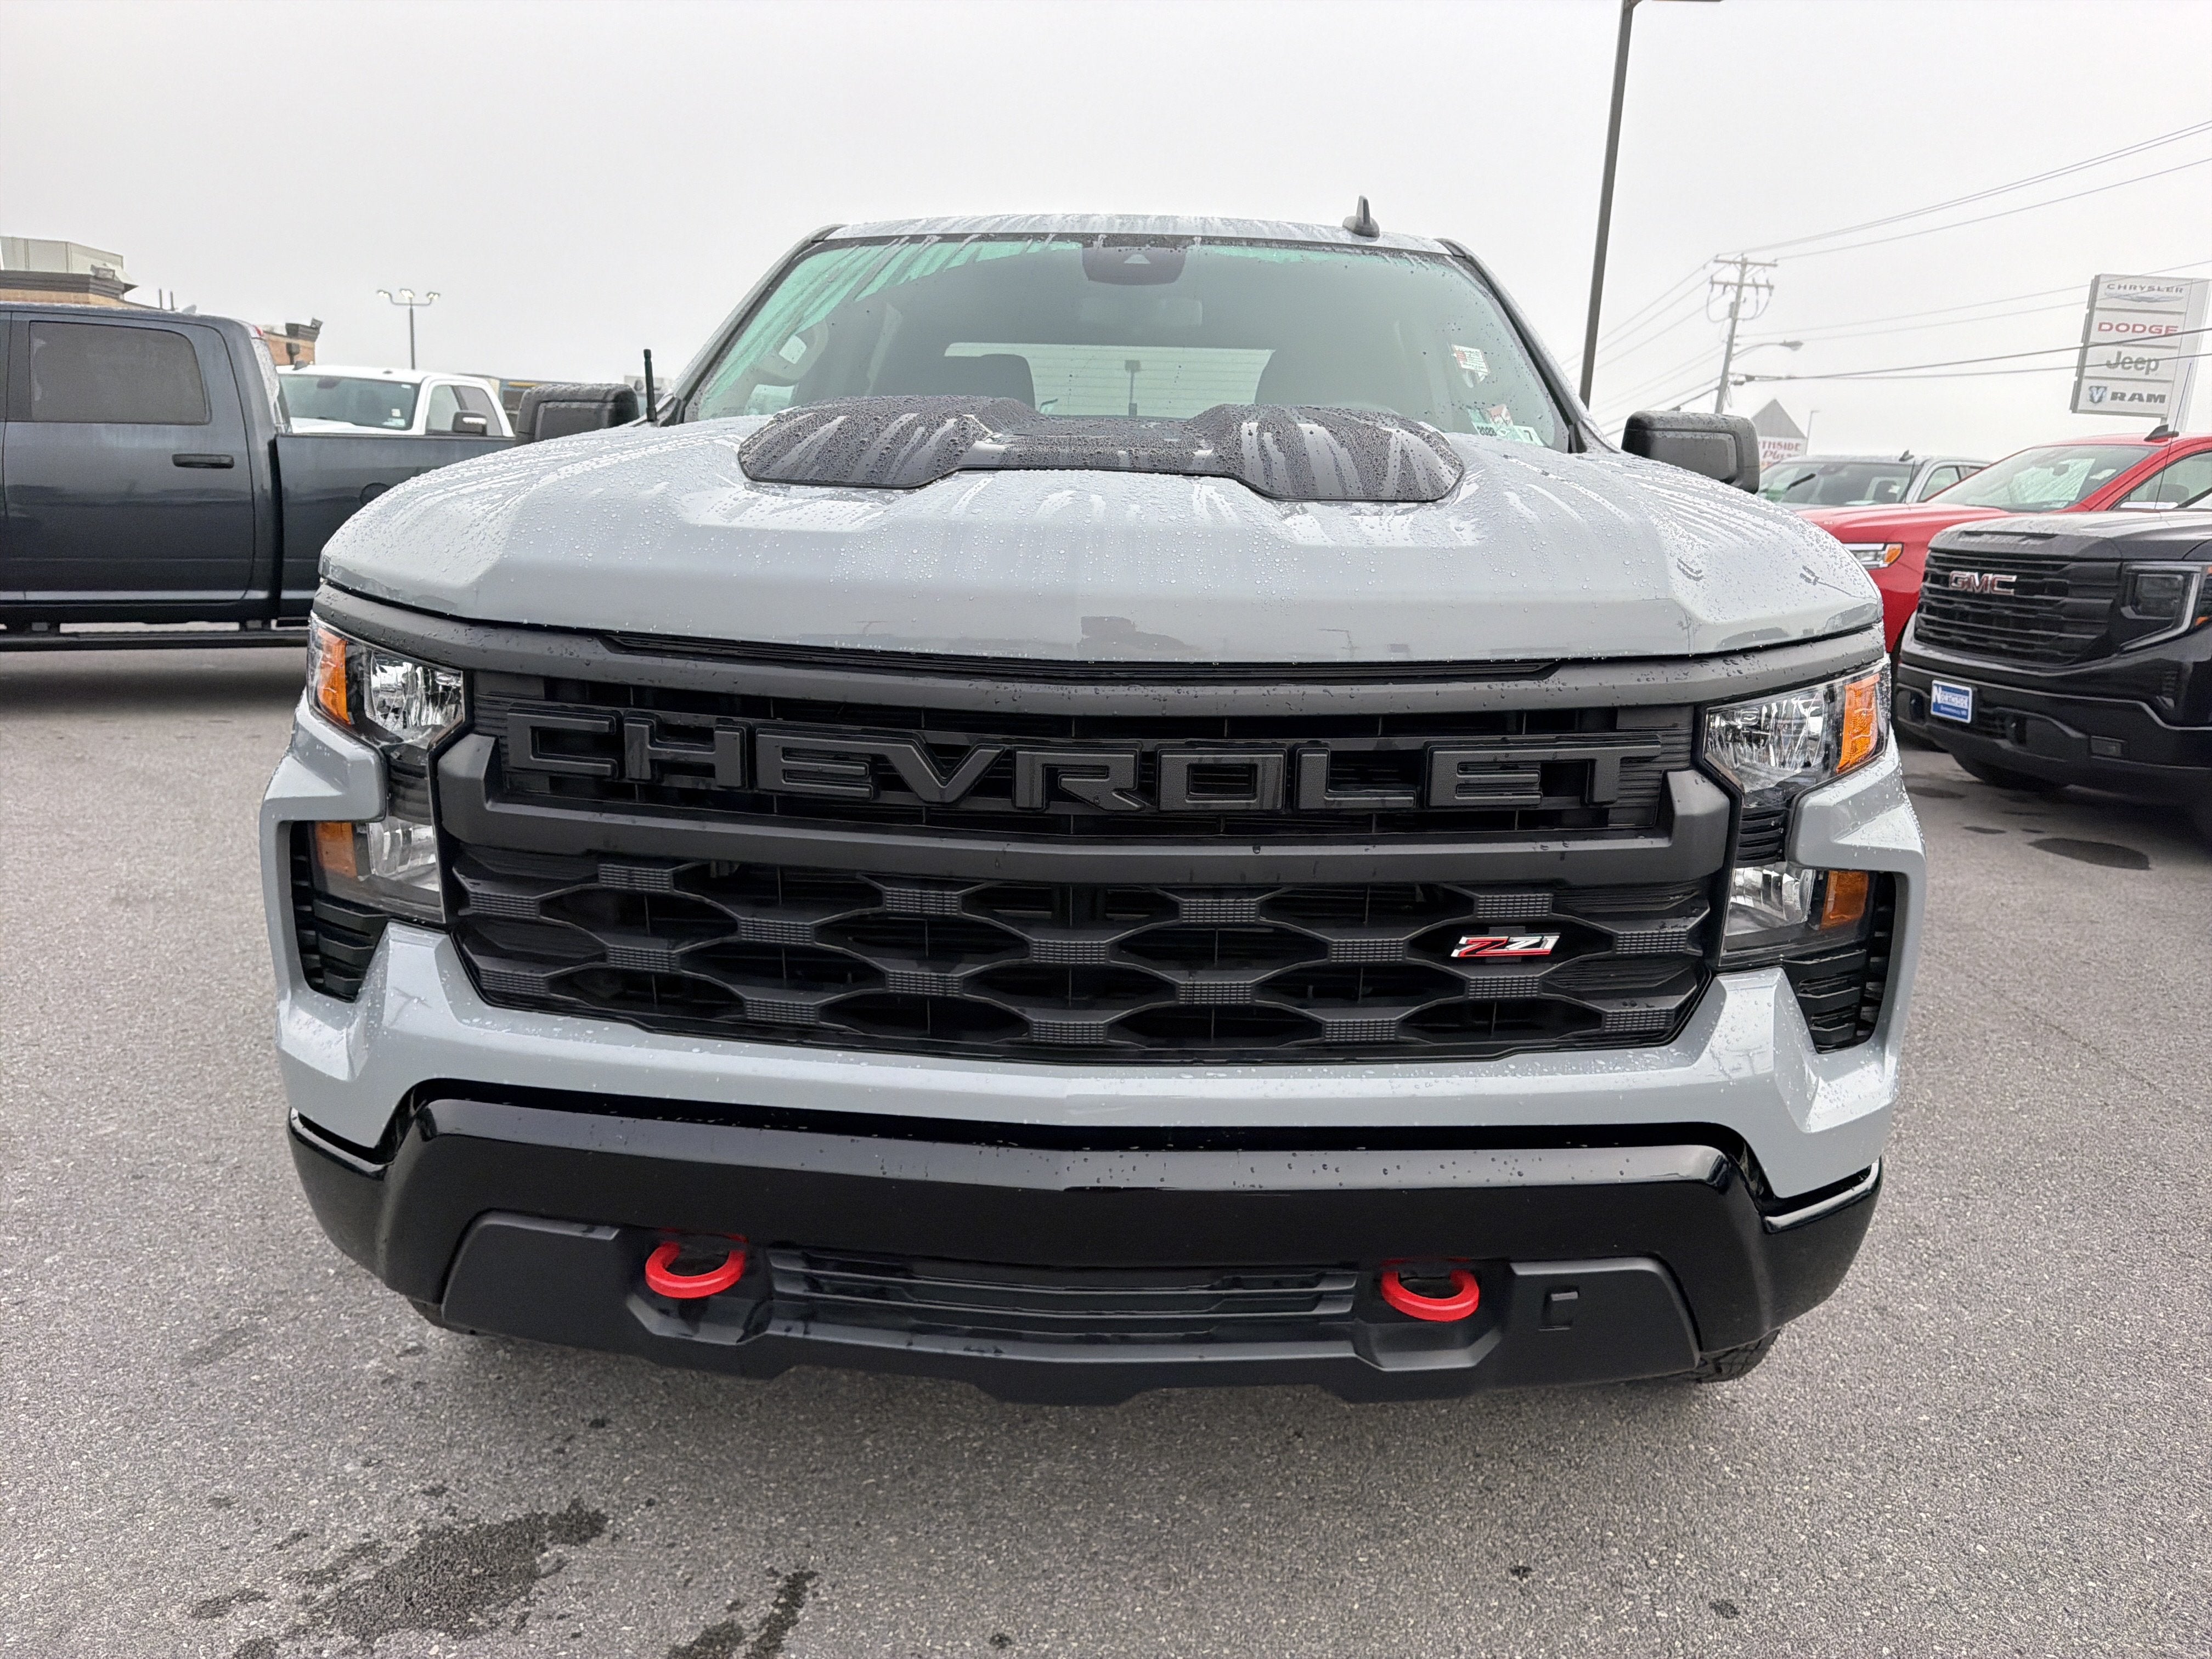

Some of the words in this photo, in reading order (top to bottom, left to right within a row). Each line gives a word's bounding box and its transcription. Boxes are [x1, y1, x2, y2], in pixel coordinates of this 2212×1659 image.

[2106, 283, 2183, 294] CHRYSLER
[2097, 322, 2179, 335] DODGE
[2106, 351, 2160, 375] Jeep
[2110, 391, 2166, 404] RAM
[1758, 441, 1801, 452] THSIDE
[1949, 570, 2017, 596] GMC
[506, 707, 1662, 812] CHEVROLET
[1451, 935, 1560, 958] Z71
